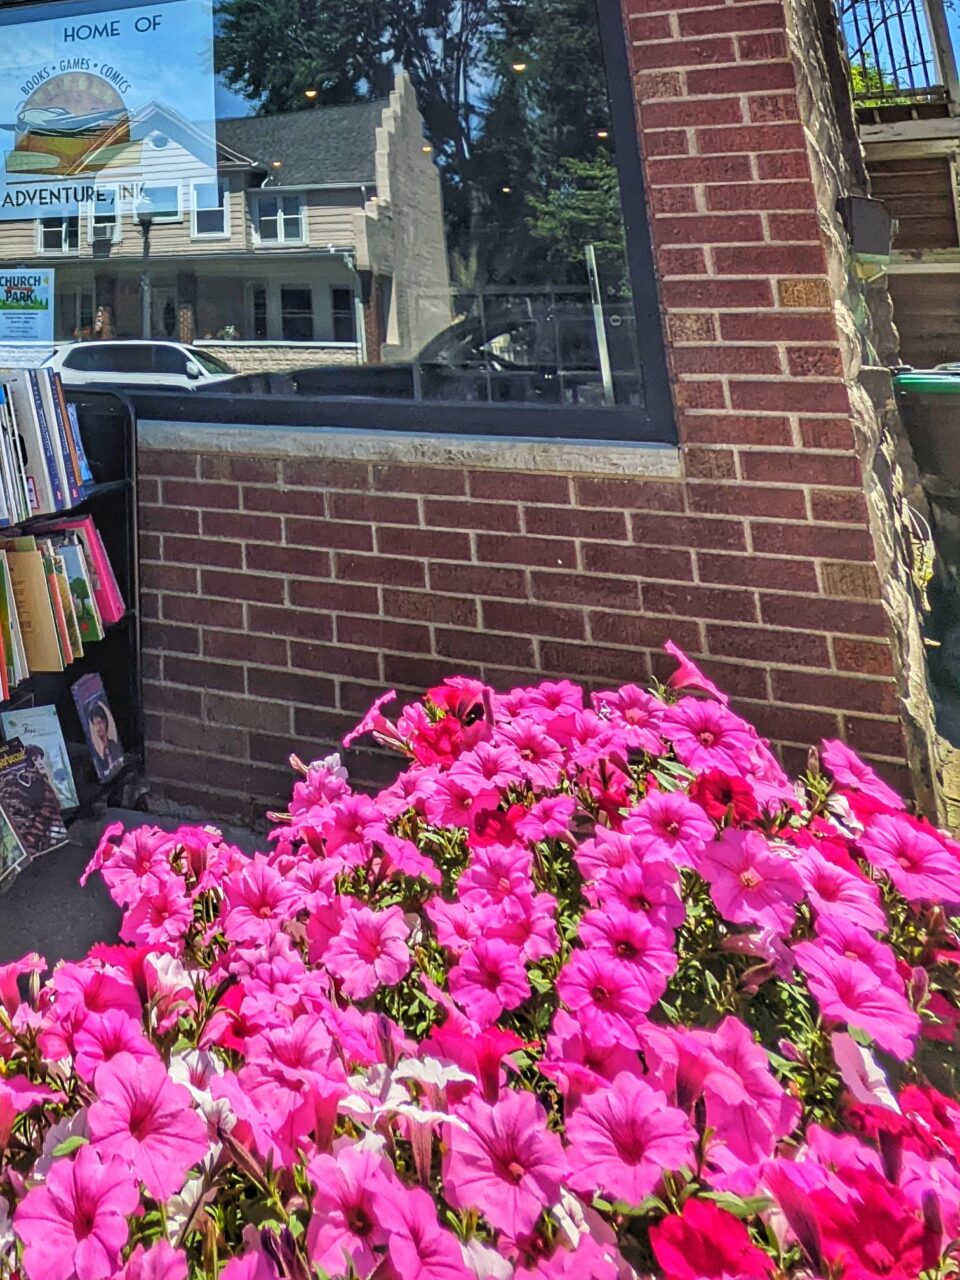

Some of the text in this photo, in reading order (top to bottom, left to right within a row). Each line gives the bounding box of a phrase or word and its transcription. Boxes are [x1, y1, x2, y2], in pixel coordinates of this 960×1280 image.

[64, 14, 162, 42] HOME OF
[20, 57, 131, 95] BOOKS GAMES COMICS
[1, 185, 115, 207] ADVENTURE,
[5, 289, 36, 304] PARK
